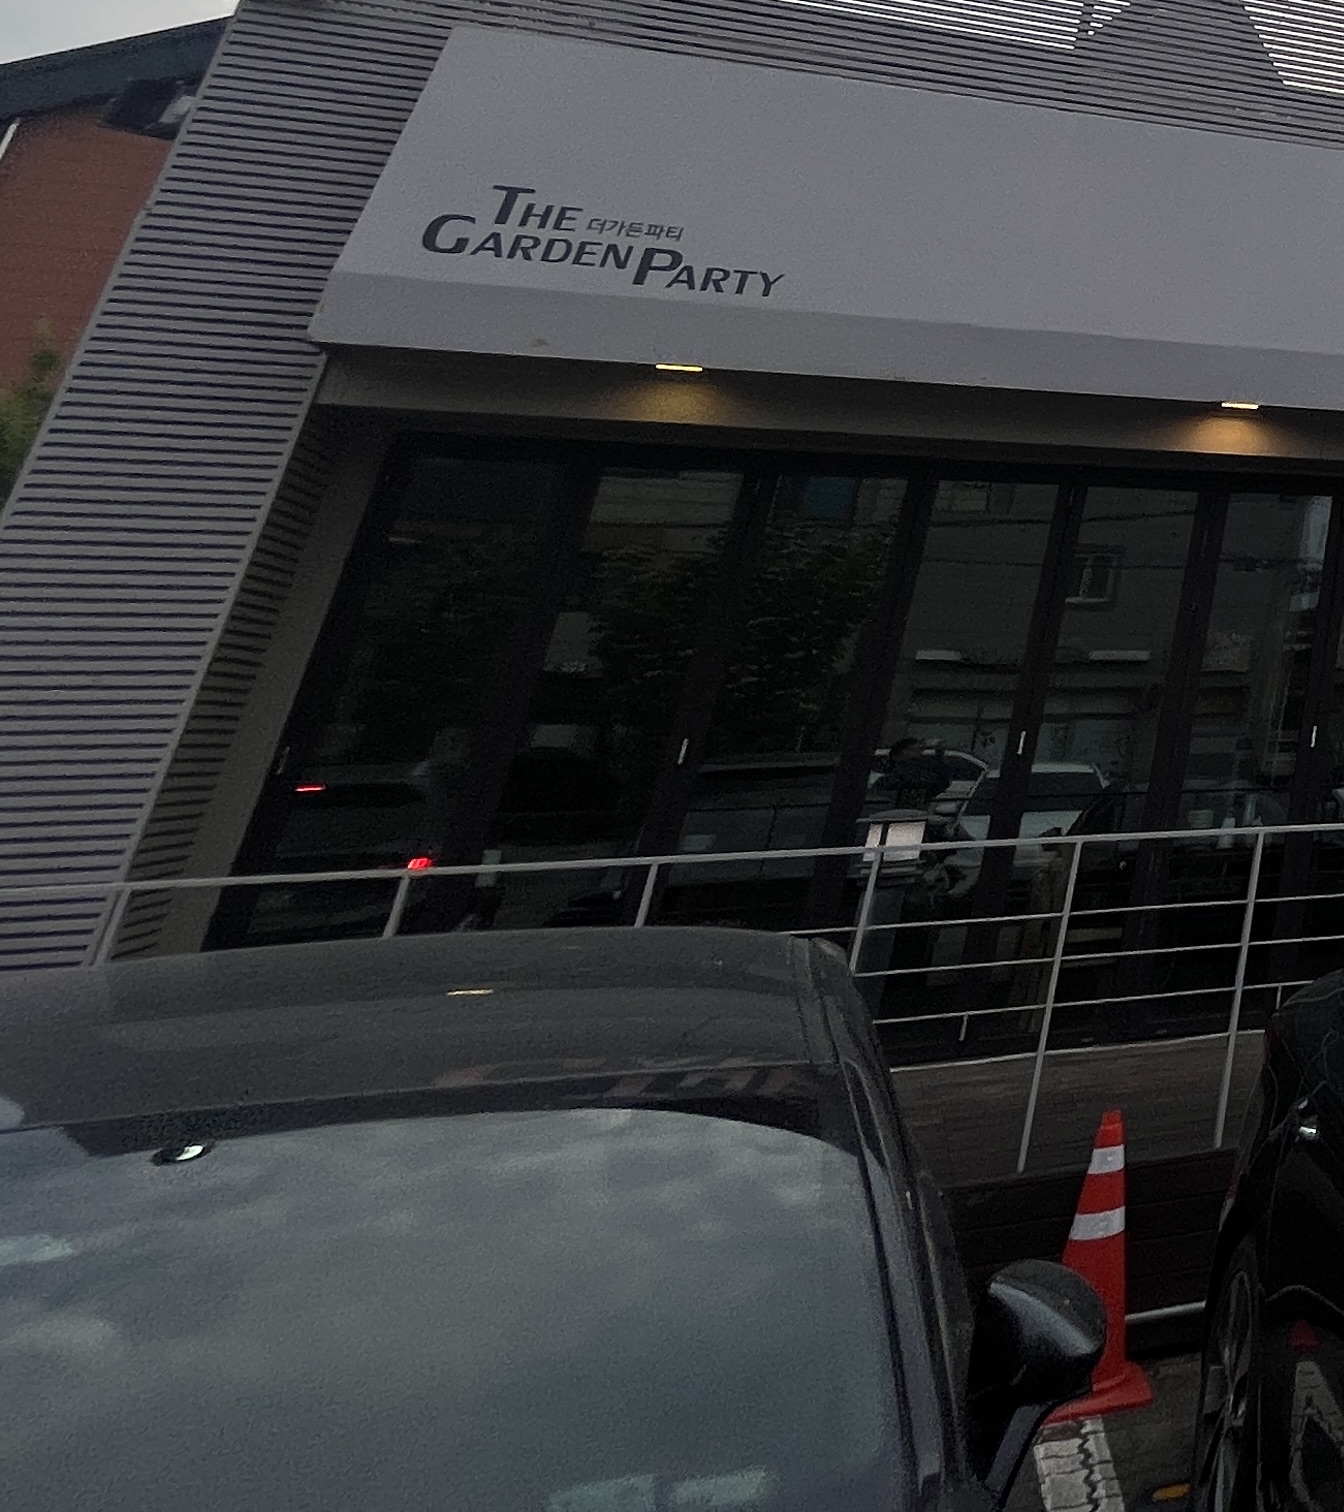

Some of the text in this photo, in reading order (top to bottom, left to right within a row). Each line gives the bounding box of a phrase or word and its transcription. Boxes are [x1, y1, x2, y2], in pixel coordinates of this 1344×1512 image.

[492, 184, 583, 232] THE
[587, 218, 685, 242] 더가든파티
[422, 213, 785, 297] GARDEN PARTY
